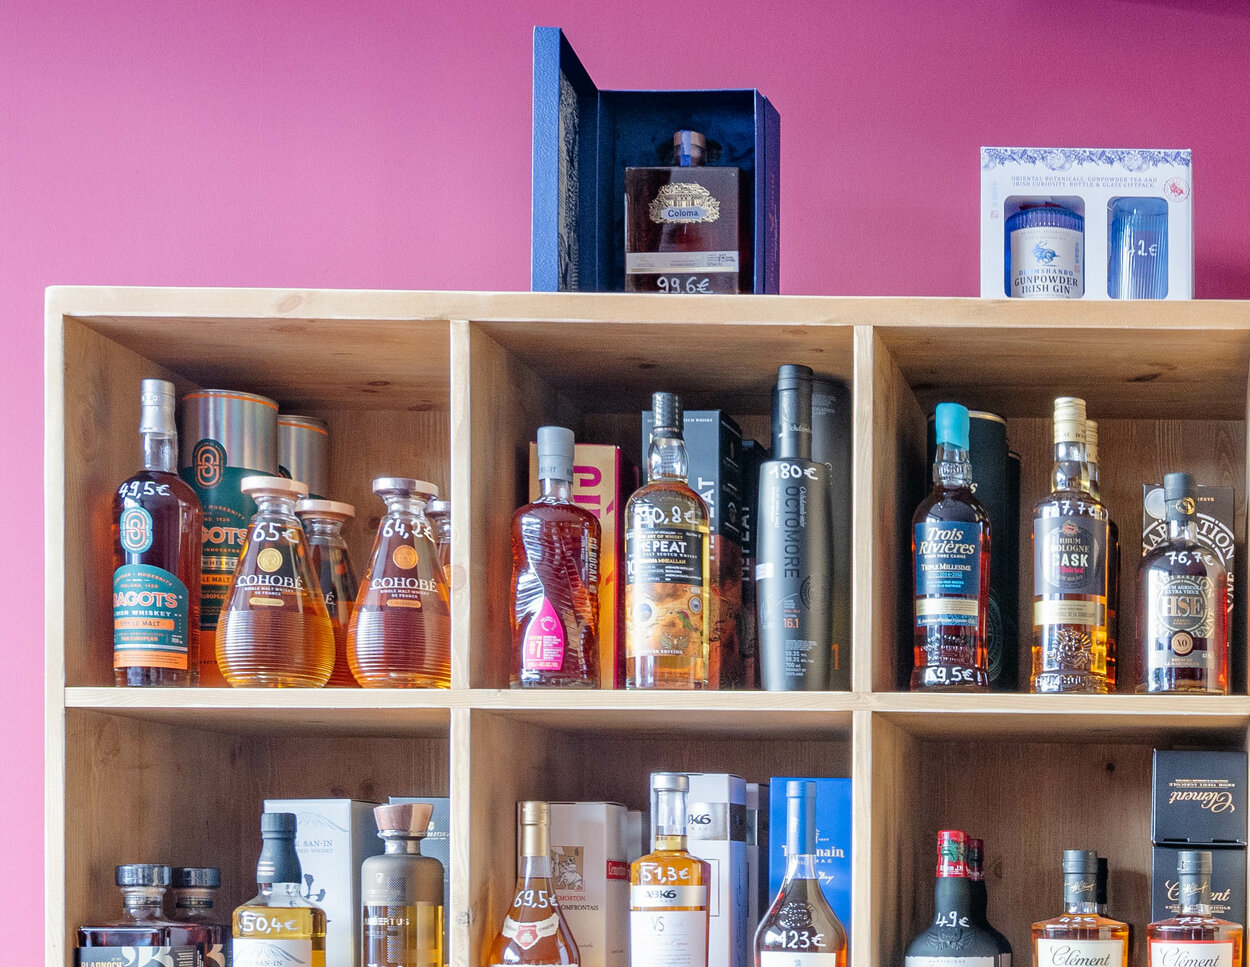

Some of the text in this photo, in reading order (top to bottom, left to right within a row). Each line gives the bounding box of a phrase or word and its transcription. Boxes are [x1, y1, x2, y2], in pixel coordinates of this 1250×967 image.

[668, 209, 698, 218] Coloma
[1014, 276, 1078, 288] GUNPOWDER
[1022, 285, 1071, 294] IRISH GIN
[118, 480, 170, 499] 49,5€
[252, 521, 300, 543] 65€
[382, 519, 436, 543] 64,2€
[784, 484, 801, 579] OCTOMORE
[925, 526, 964, 541] Trois
[918, 540, 976, 556] Rivières
[1052, 554, 1088, 568] CASK
[1165, 551, 1215, 567] 76,7€
[236, 575, 304, 589] COHOBÉ
[371, 577, 438, 591] COHOBÉ
[1161, 596, 1204, 616] HSE
[784, 618, 800, 628] 16.1
[1176, 638, 1188, 648] XO
[1170, 792, 1236, 813] Clément
[640, 864, 691, 883] 51,3€
[514, 889, 560, 910] 69,5€
[242, 913, 300, 934] 50,4€
[936, 911, 970, 928] 49€
[1050, 945, 1111, 967] Clément
